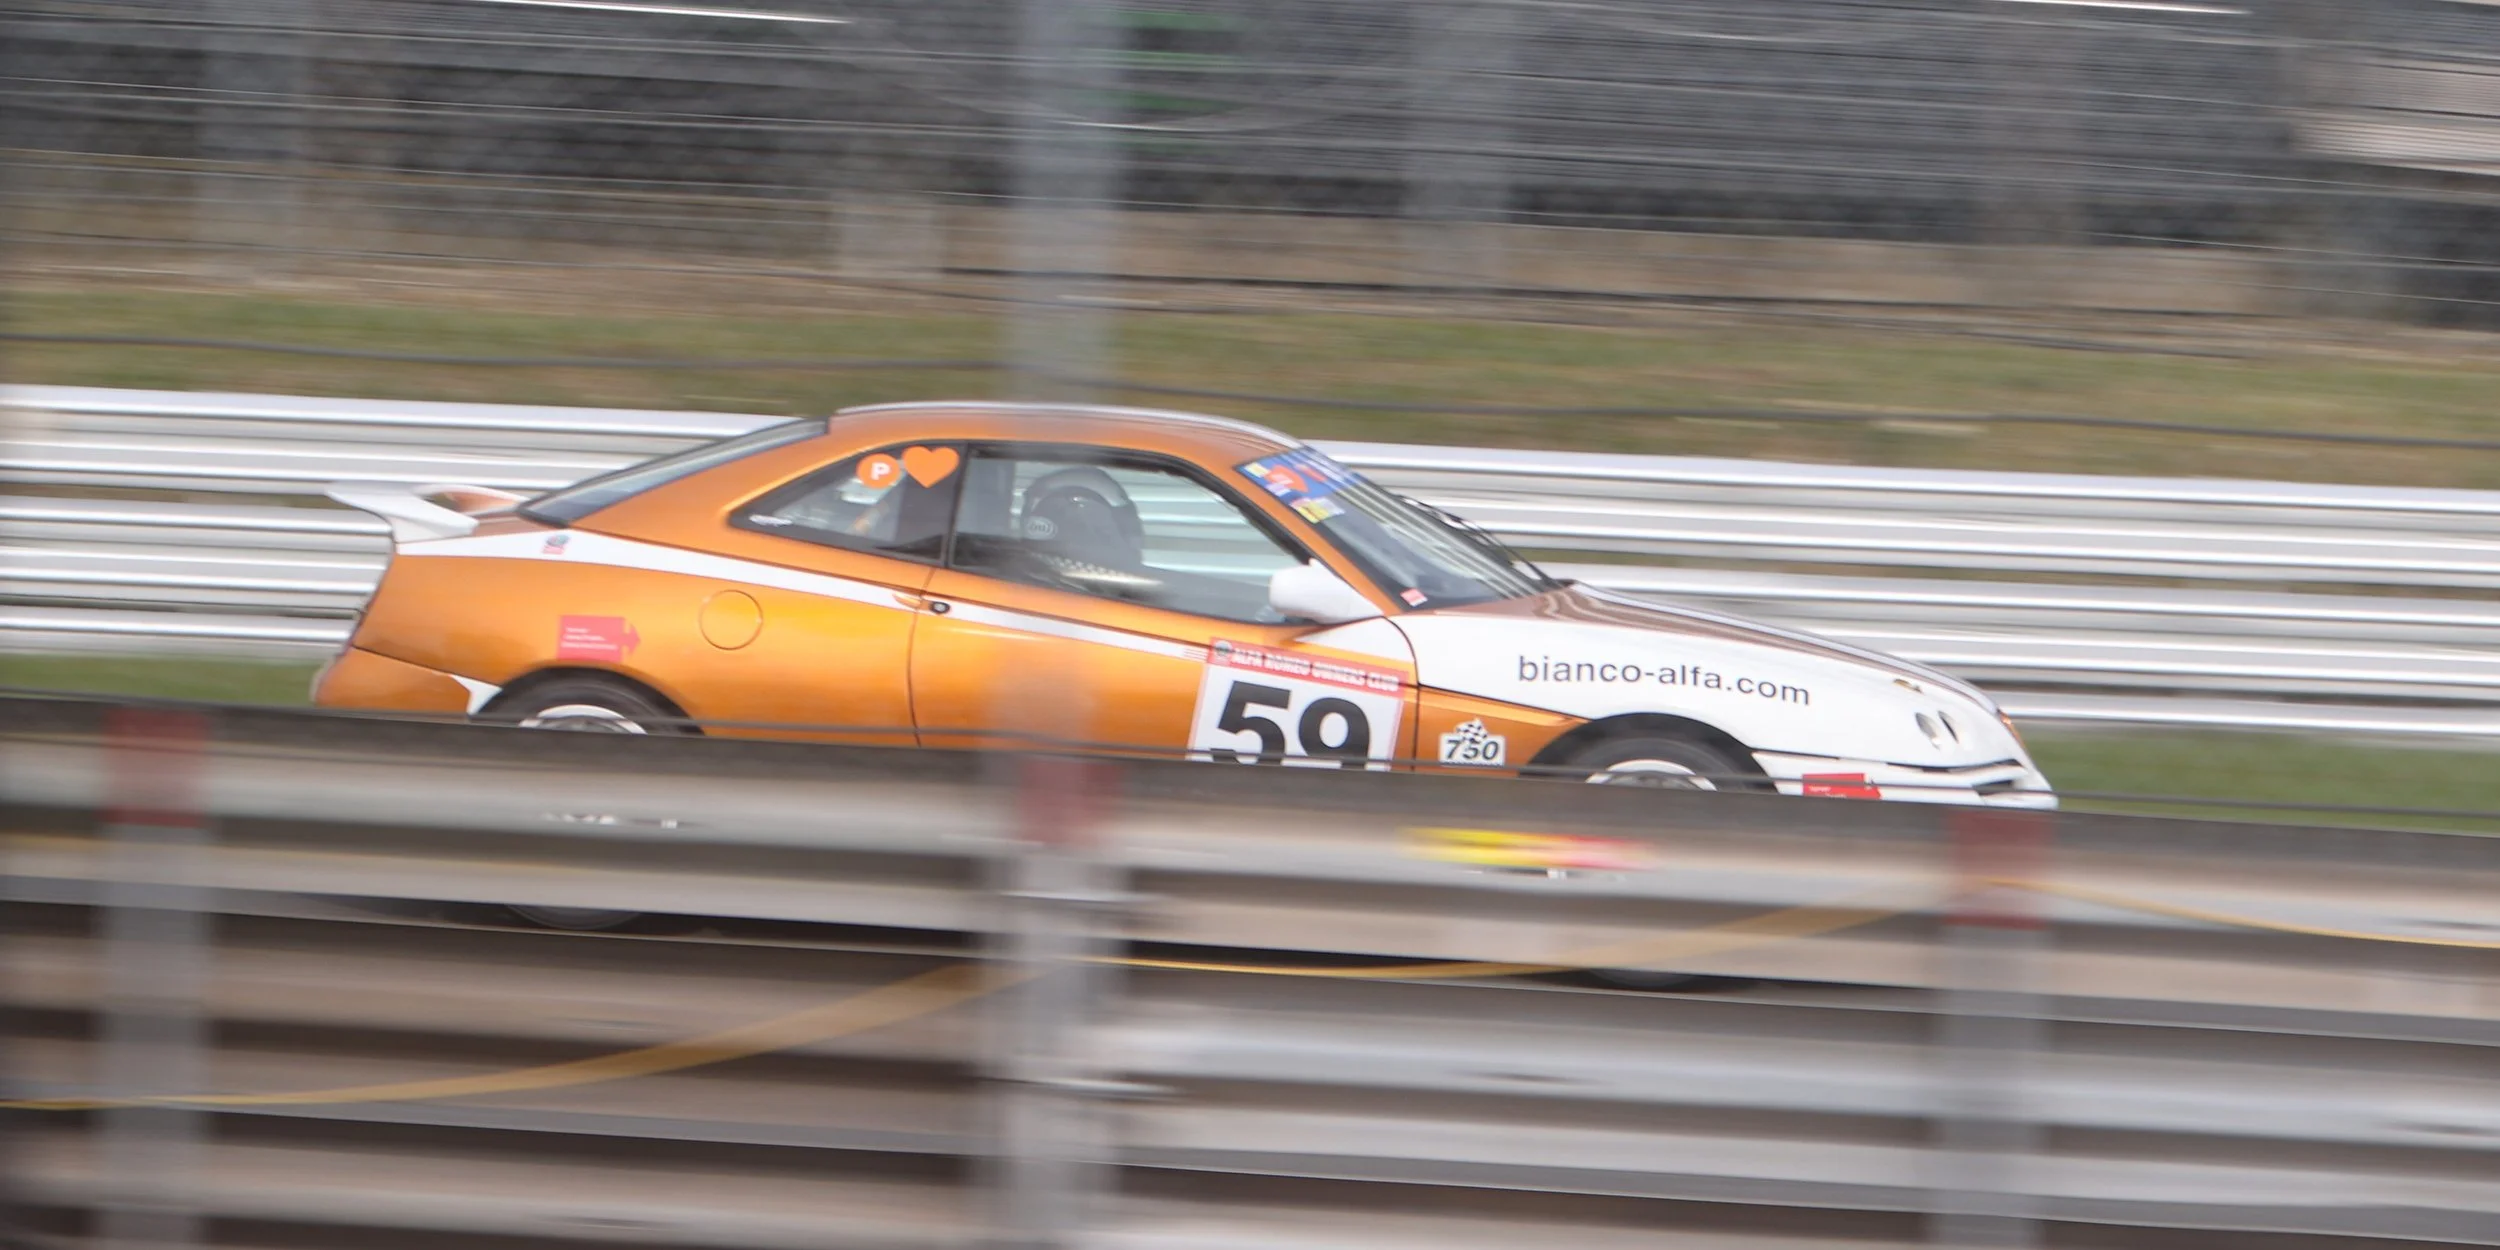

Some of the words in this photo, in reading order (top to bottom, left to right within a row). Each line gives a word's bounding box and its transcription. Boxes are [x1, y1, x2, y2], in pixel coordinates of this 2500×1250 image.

[870, 461, 892, 481] P
[1231, 647, 1263, 669] ALFA
[1518, 656, 1811, 705] bianco-alfa.com
[1209, 680, 1370, 769] 59
[1446, 739, 1499, 761] 750
